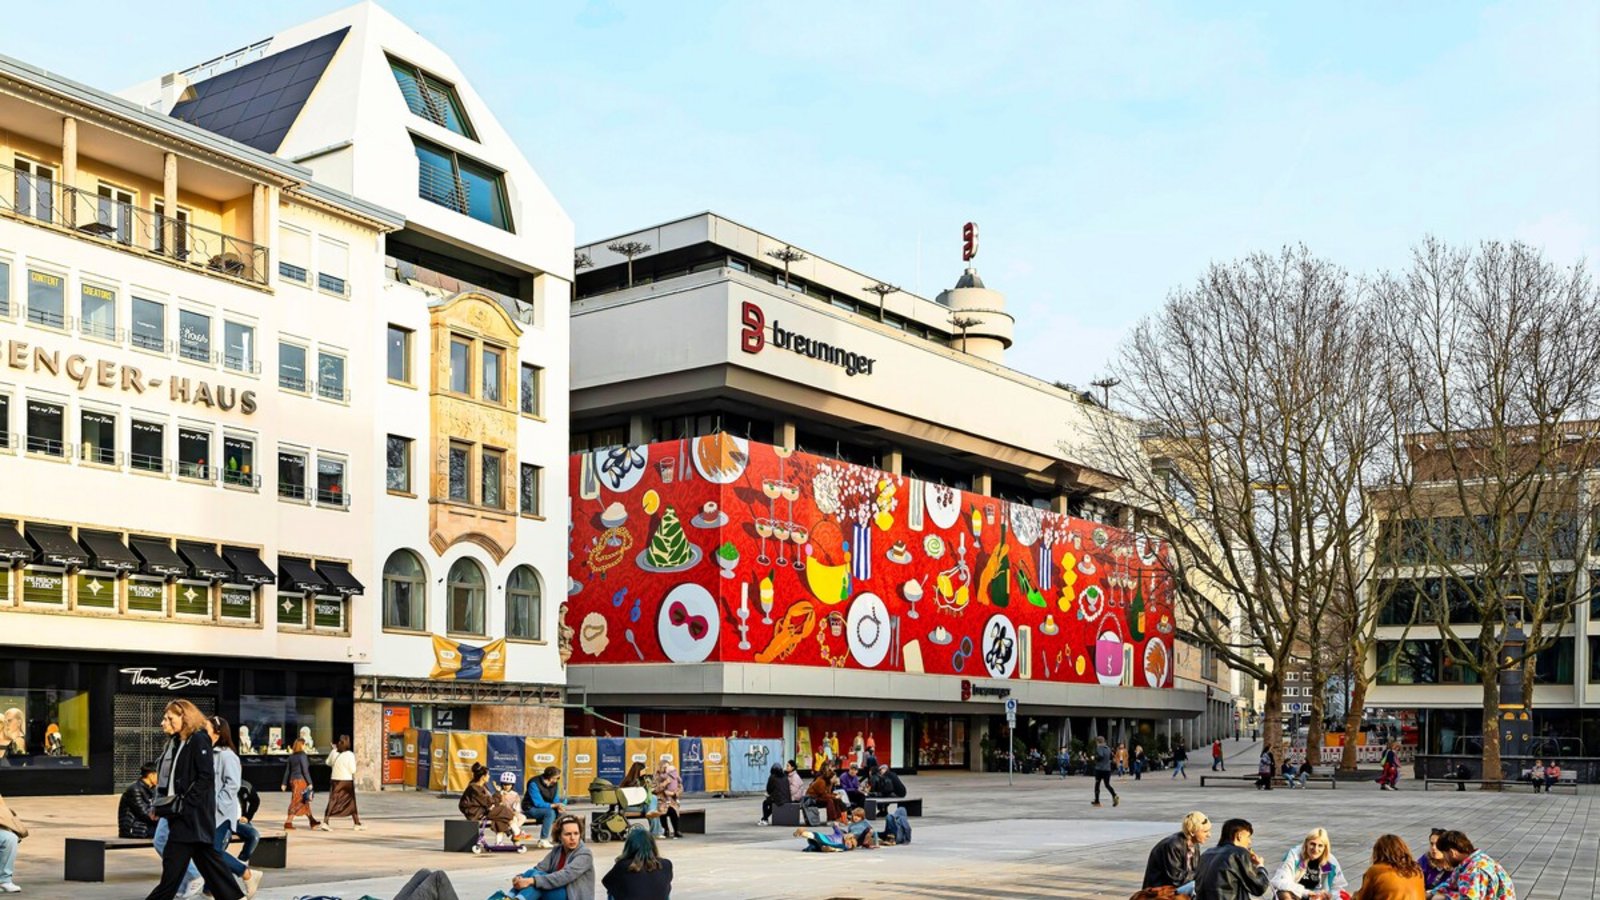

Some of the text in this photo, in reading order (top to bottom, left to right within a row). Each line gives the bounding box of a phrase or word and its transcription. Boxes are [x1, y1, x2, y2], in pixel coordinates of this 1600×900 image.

[773, 320, 876, 376] breuninger
[0, 339, 258, 416] ENGER-HAUS
[119, 668, 217, 690] Thomas Sabo
